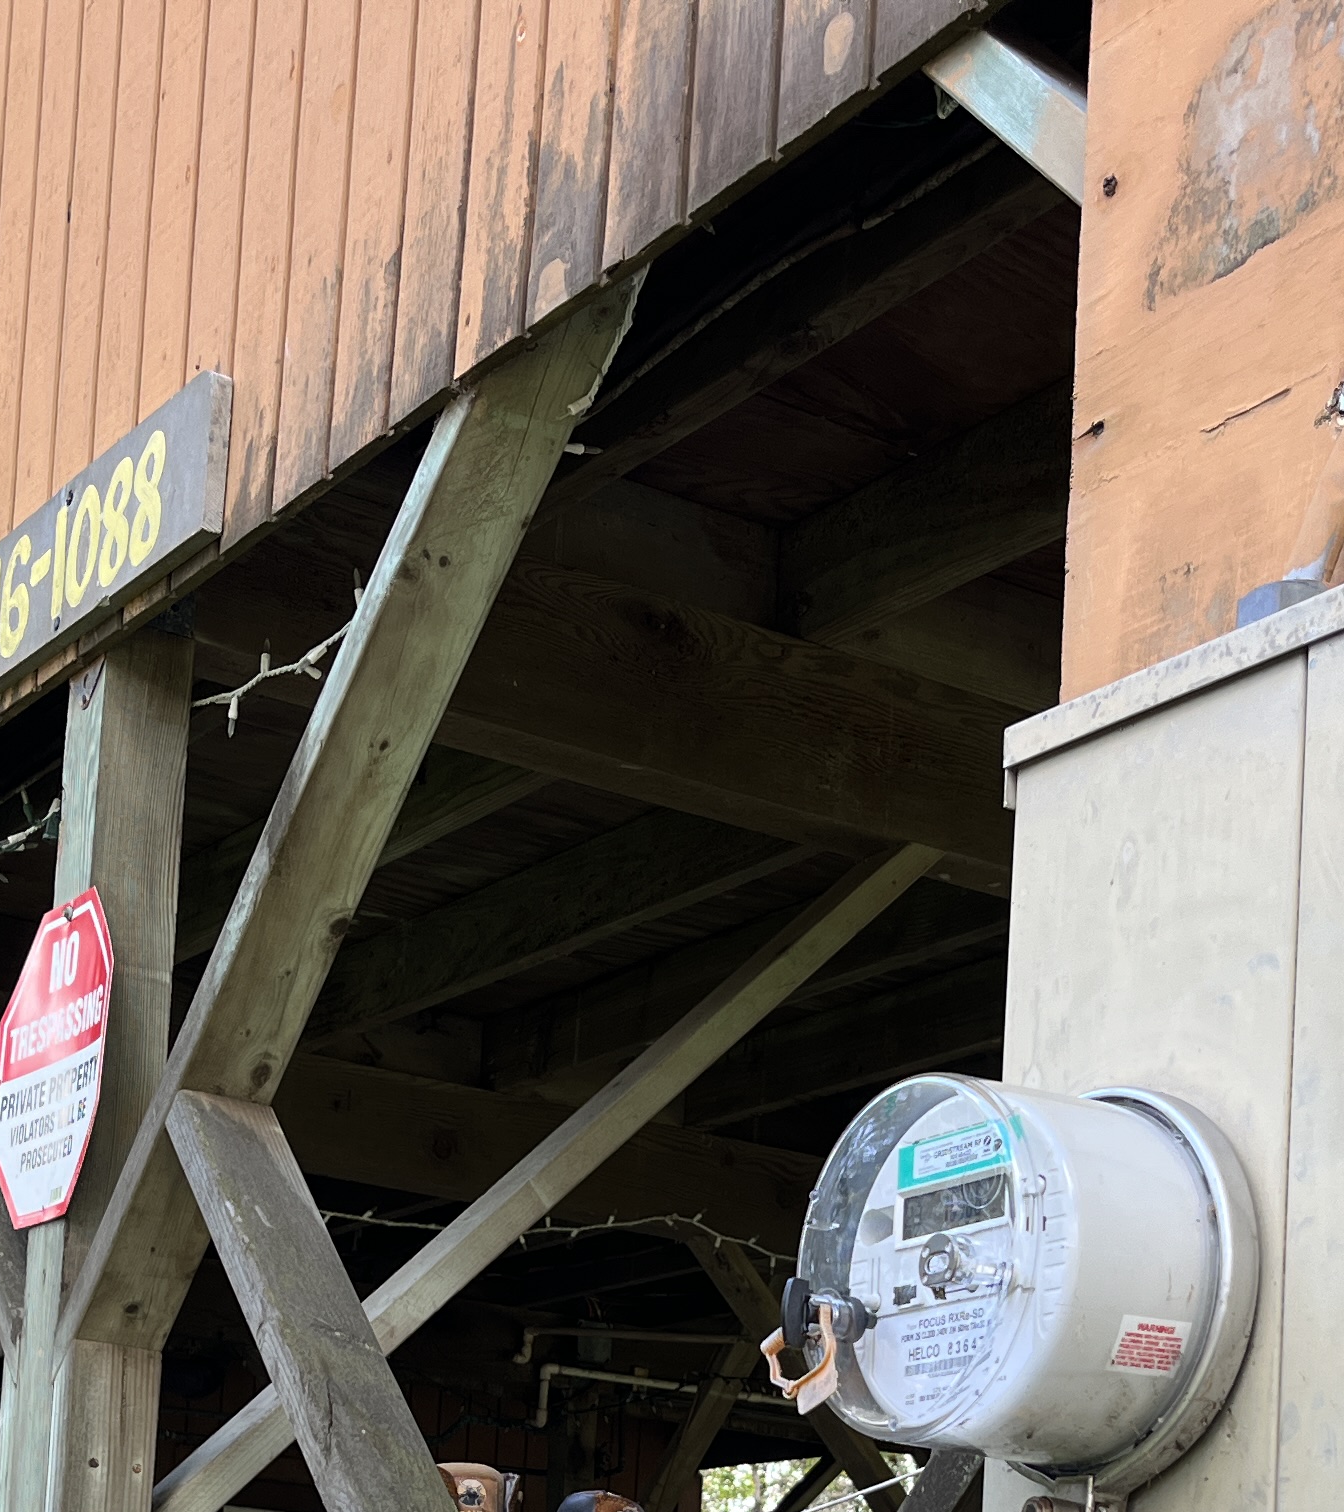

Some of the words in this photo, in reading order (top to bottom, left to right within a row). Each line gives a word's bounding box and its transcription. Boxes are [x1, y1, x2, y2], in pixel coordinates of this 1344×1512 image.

[49, 930, 79, 994] NO
[10, 983, 104, 1065] TRESPASSING
[0, 1081, 47, 1122] PRIVATE
[48, 1052, 99, 1105] PROPERTY
[10, 1111, 56, 1147] VIOLATORS
[77, 1097, 87, 1122] BE
[19, 1134, 73, 1173] PROSECUTED
[918, 1314, 946, 1330] FOCUS
[908, 1343, 940, 1361] HELCO
